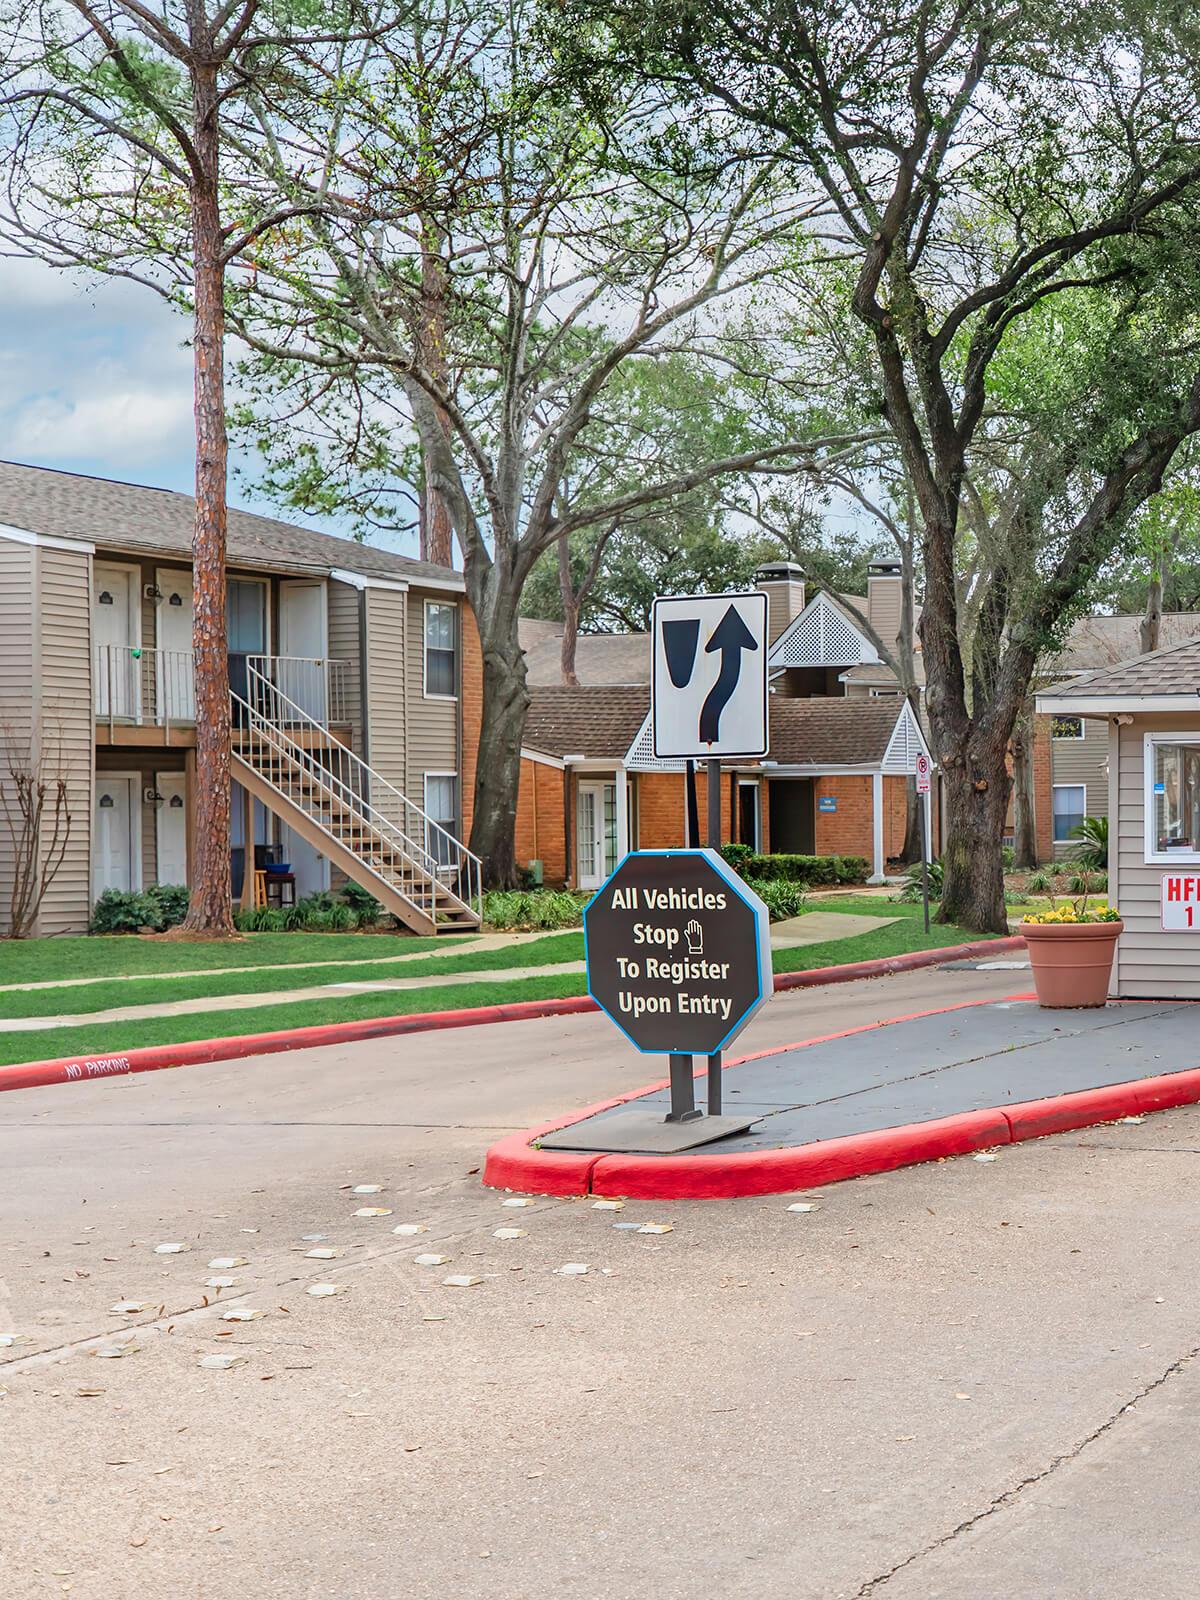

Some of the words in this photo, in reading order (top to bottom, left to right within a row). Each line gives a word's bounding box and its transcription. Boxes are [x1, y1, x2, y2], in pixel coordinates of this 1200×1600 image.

[611, 887, 638, 910] All
[643, 887, 727, 910] Vehicles
[1184, 906, 1193, 928] 1
[633, 923, 680, 950] Stop
[616, 957, 640, 979] To
[646, 957, 730, 985] Register
[618, 991, 671, 1018] Upon
[678, 993, 733, 1020] Entry
[64, 1064, 82, 1080] NO
[85, 1057, 130, 1075] PARKING
